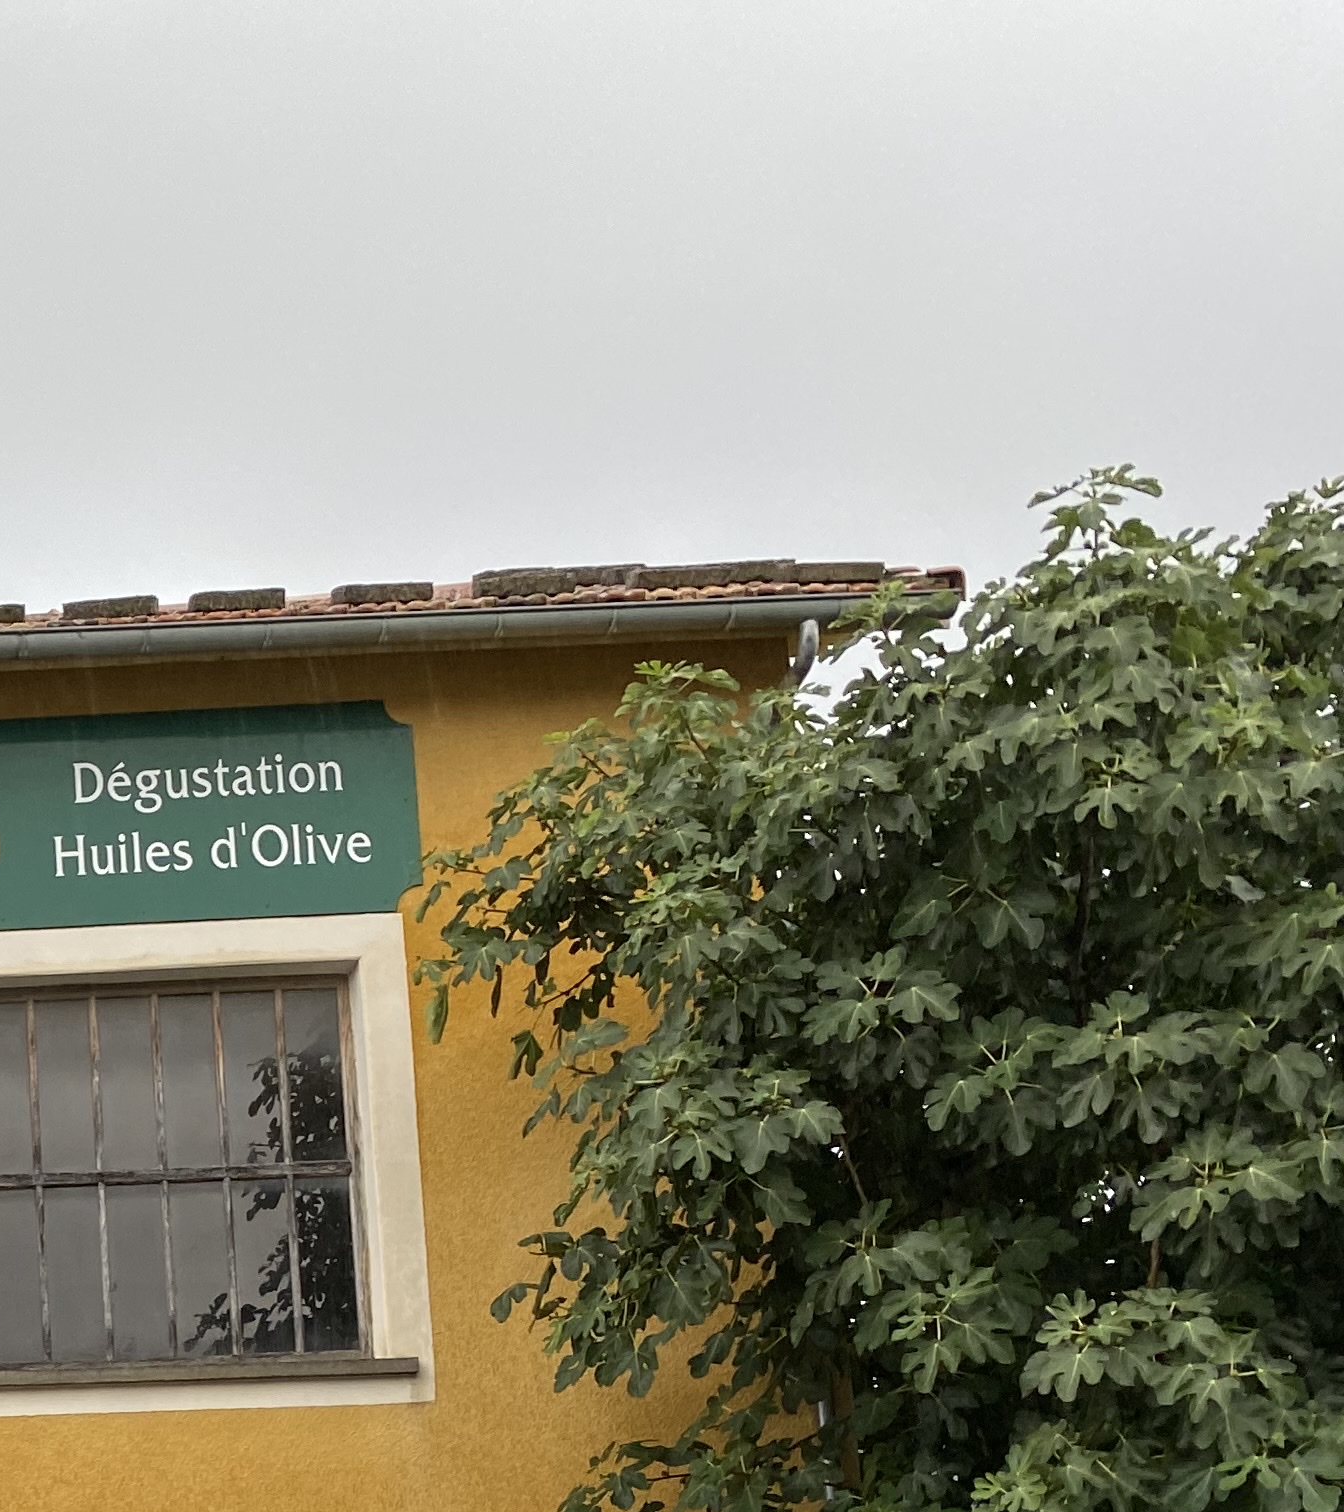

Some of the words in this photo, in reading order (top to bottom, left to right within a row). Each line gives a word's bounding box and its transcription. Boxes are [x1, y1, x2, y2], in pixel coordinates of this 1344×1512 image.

[73, 754, 344, 813] Dégustation
[53, 831, 193, 878] Huiles
[210, 821, 373, 870] d'Olive
